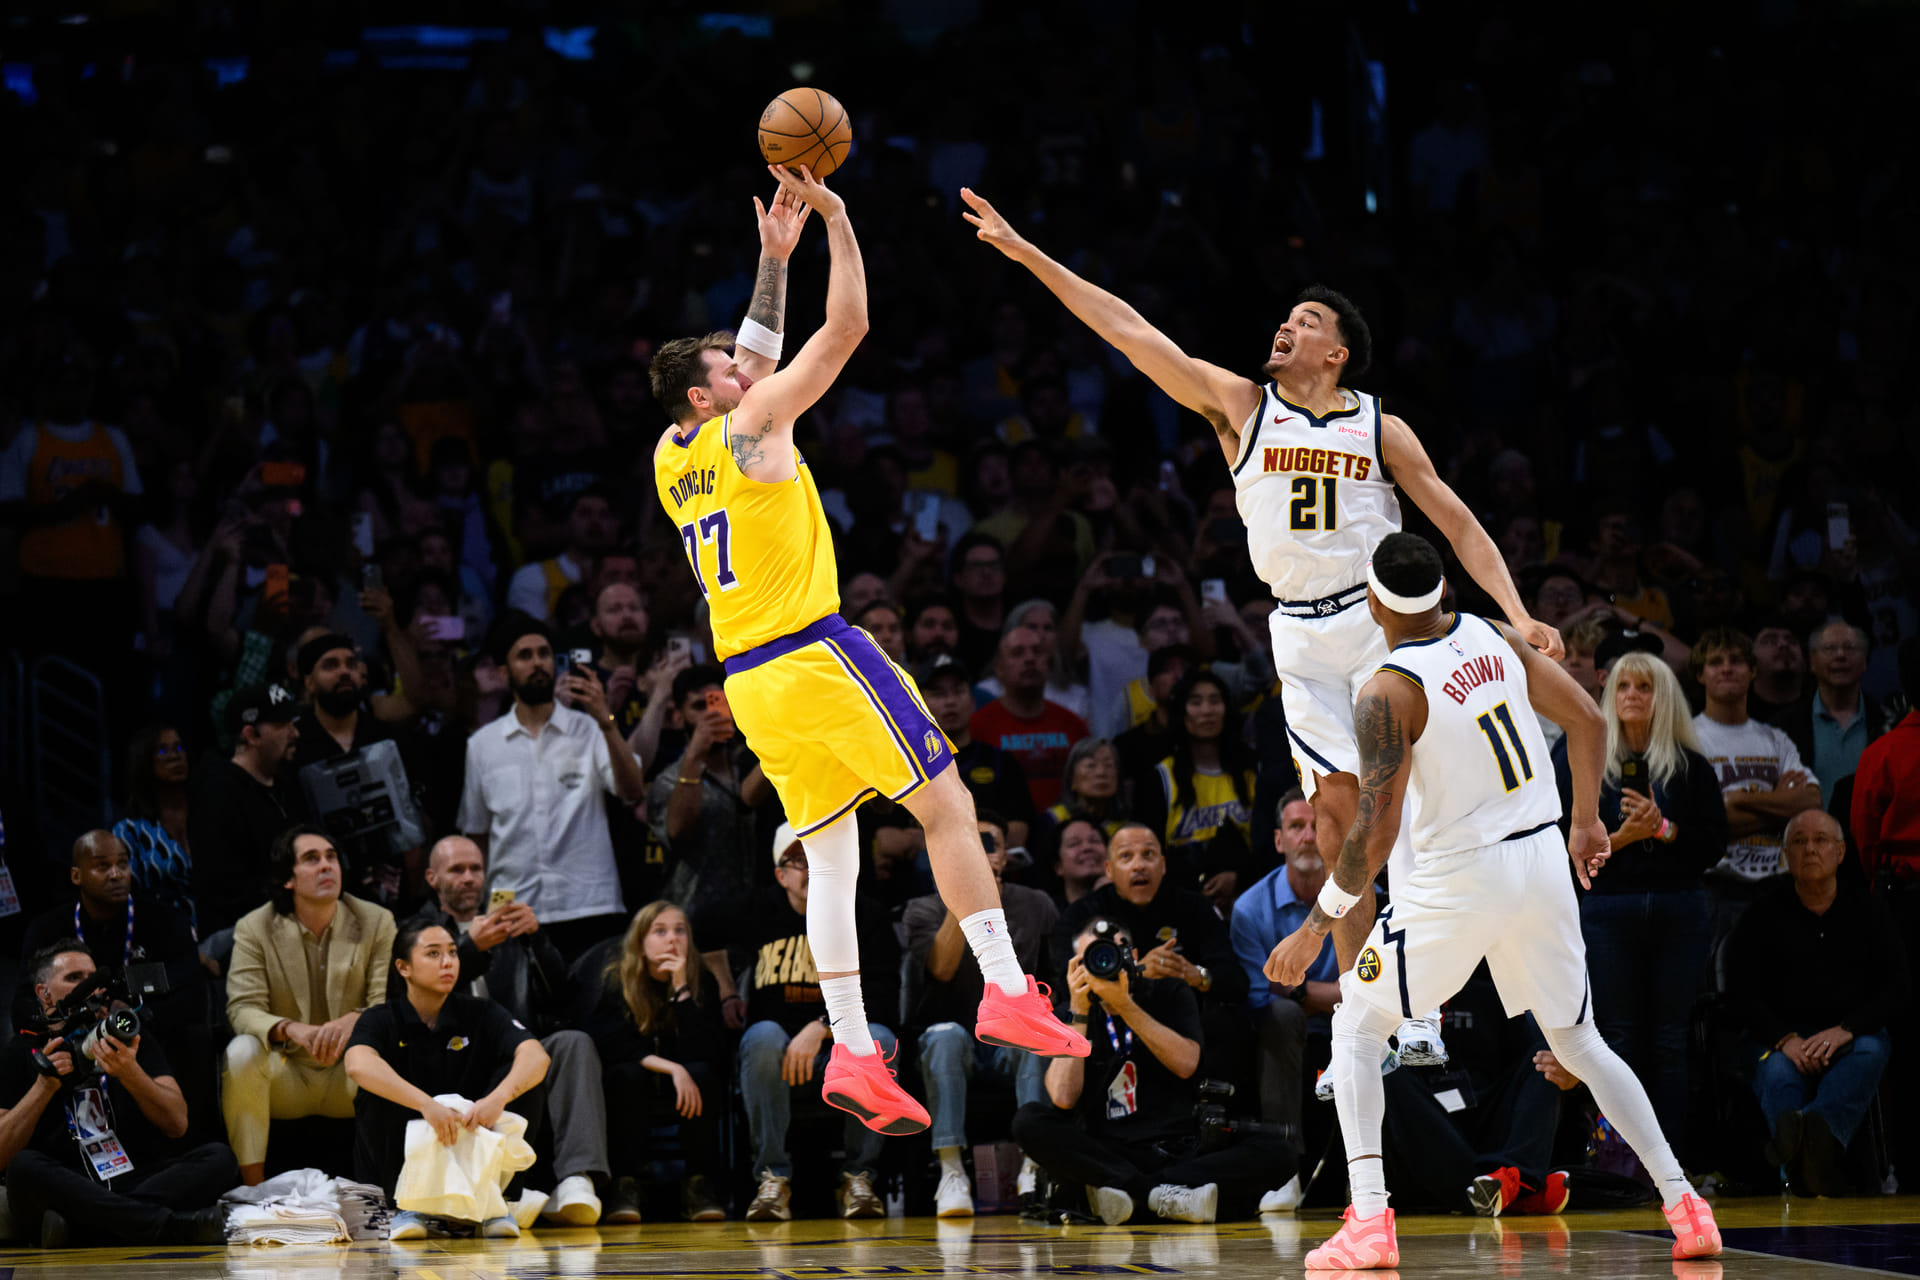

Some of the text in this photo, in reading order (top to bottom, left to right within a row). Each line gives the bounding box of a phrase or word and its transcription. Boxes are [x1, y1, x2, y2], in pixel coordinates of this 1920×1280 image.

[1338, 425, 1368, 438] ibotta
[669, 465, 716, 509] DONČIĆ
[1263, 447, 1372, 481] NUGGETS
[1290, 476, 1337, 531] 21
[680, 507, 740, 600] 77
[1442, 655, 1505, 705] BROWN
[1476, 700, 1534, 793] 11
